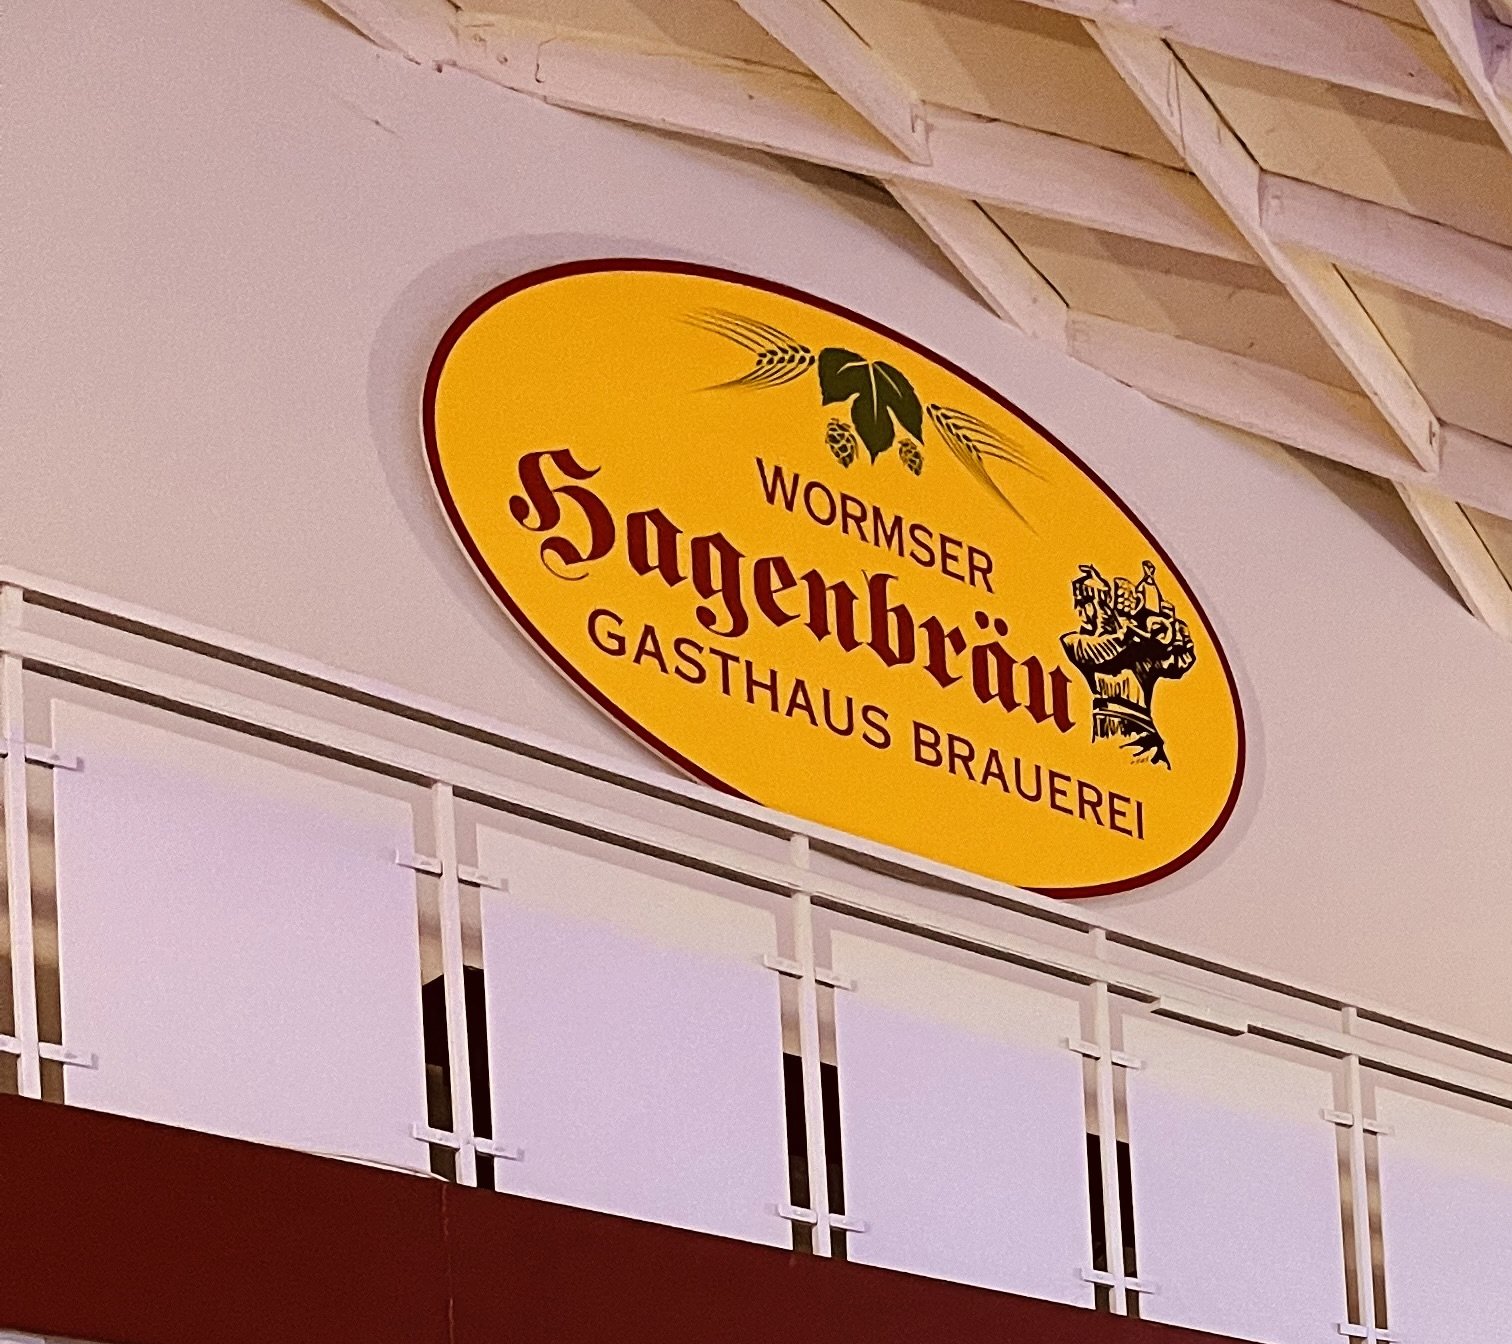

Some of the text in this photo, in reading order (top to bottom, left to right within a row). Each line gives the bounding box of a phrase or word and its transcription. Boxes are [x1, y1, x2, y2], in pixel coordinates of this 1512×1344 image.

[508, 447, 1077, 735] Hagenbräu
[755, 456, 994, 594] WORMSER
[587, 608, 1145, 841] GASTHAUS BRAUEREI
